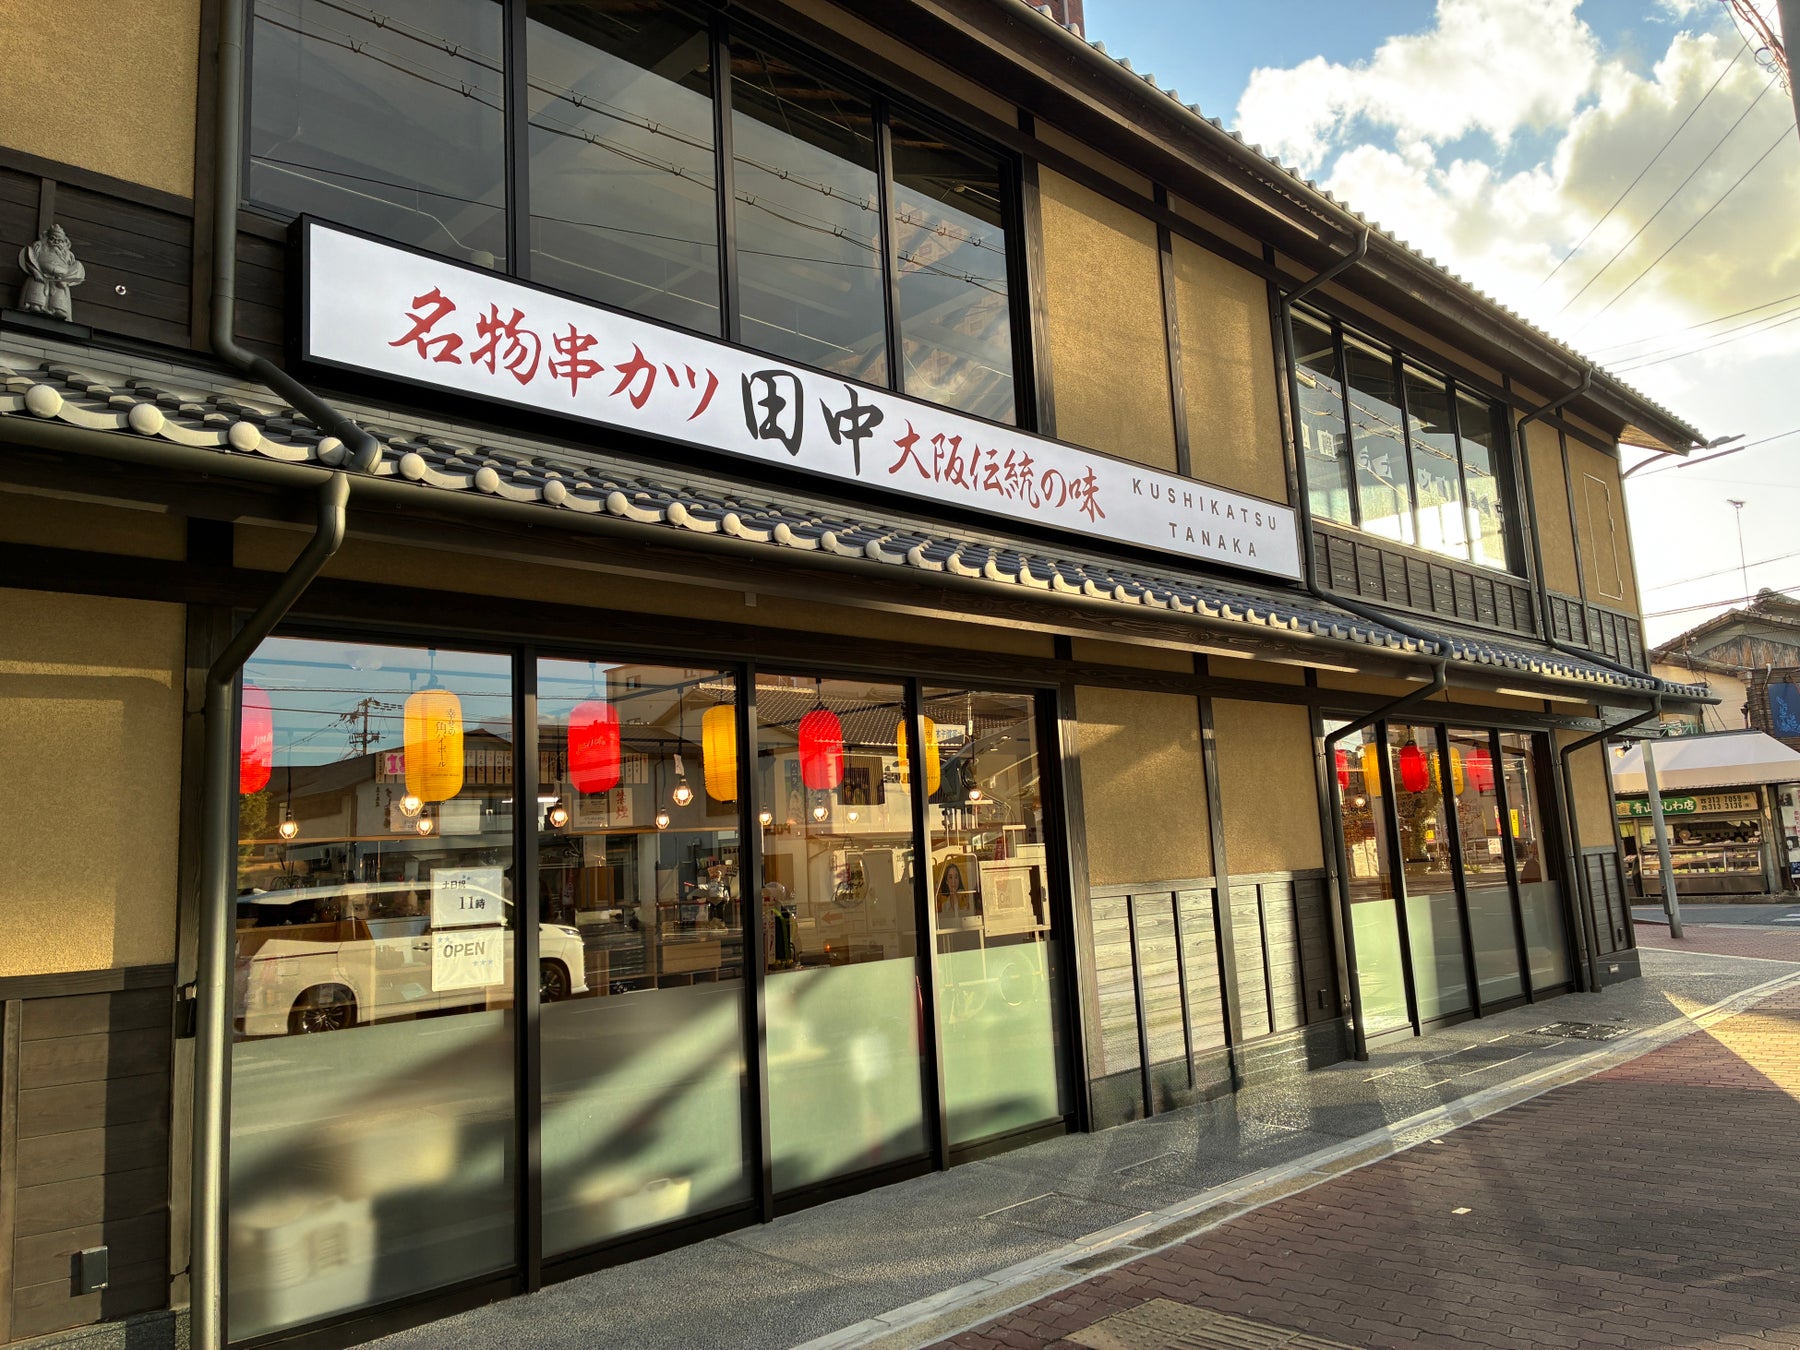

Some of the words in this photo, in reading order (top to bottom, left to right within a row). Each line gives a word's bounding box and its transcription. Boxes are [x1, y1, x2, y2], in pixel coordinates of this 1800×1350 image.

[388, 286, 719, 422] 名物串カツ
[741, 369, 885, 476] 田中
[888, 418, 1106, 523] 大阪伝統の味
[1132, 477, 1277, 531] KUSHIKATSU
[1168, 521, 1257, 558] TANAKA
[435, 721, 447, 768] 角ハイボール
[1632, 799, 1694, 815] 青山しわ店
[458, 896, 486, 910] 11時
[443, 941, 486, 958] OPEN
